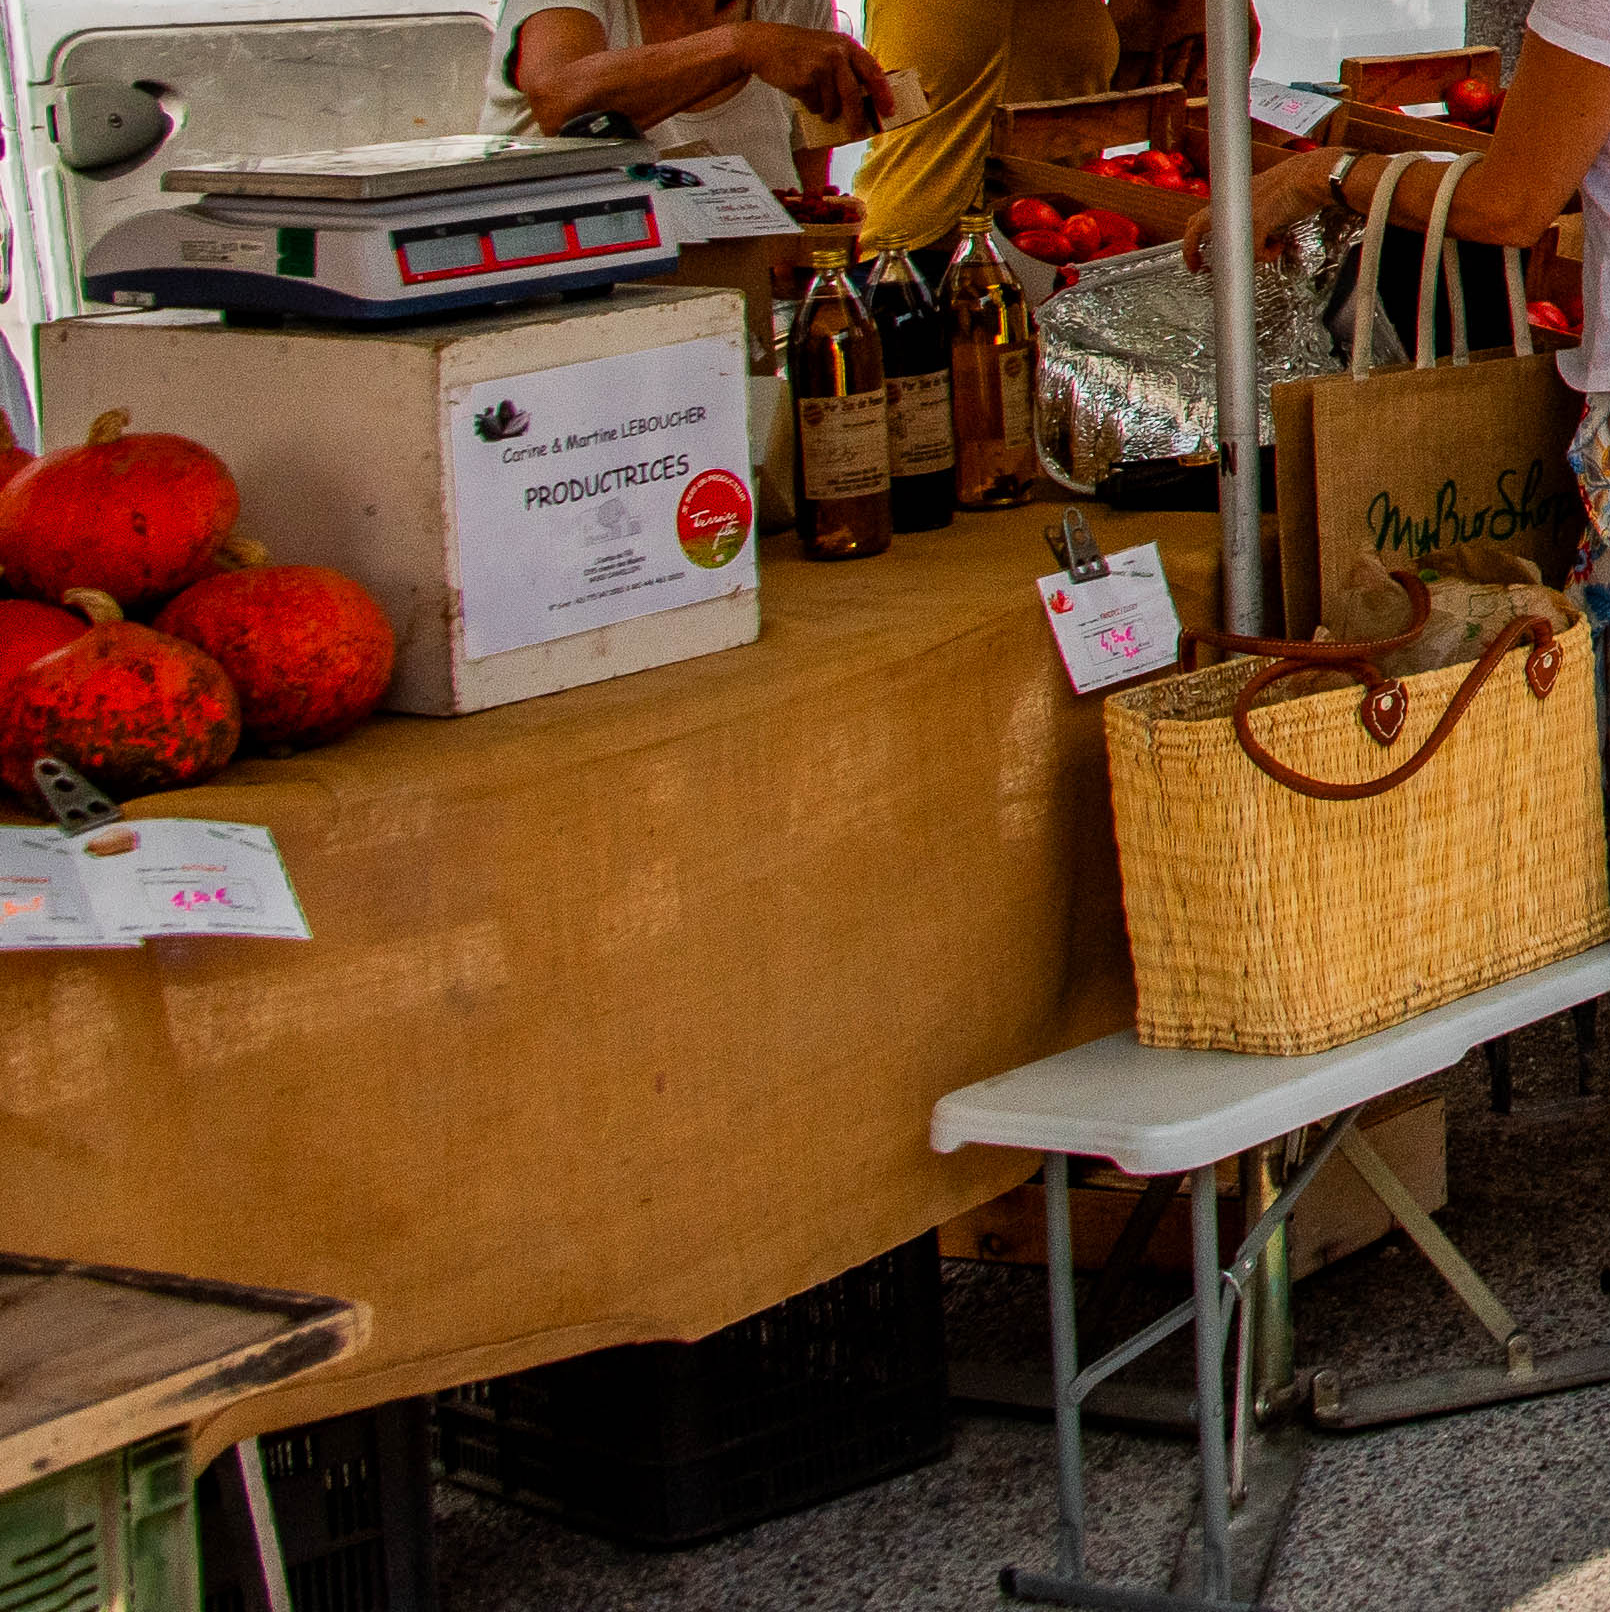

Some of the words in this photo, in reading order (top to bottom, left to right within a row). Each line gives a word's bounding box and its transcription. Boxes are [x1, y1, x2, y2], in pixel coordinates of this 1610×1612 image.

[502, 441, 548, 464] Carine
[551, 437, 562, 454] &
[566, 428, 618, 451] Martine
[621, 405, 707, 440] LEBOUCHER
[523, 453, 691, 512] PRODUCTRICES
